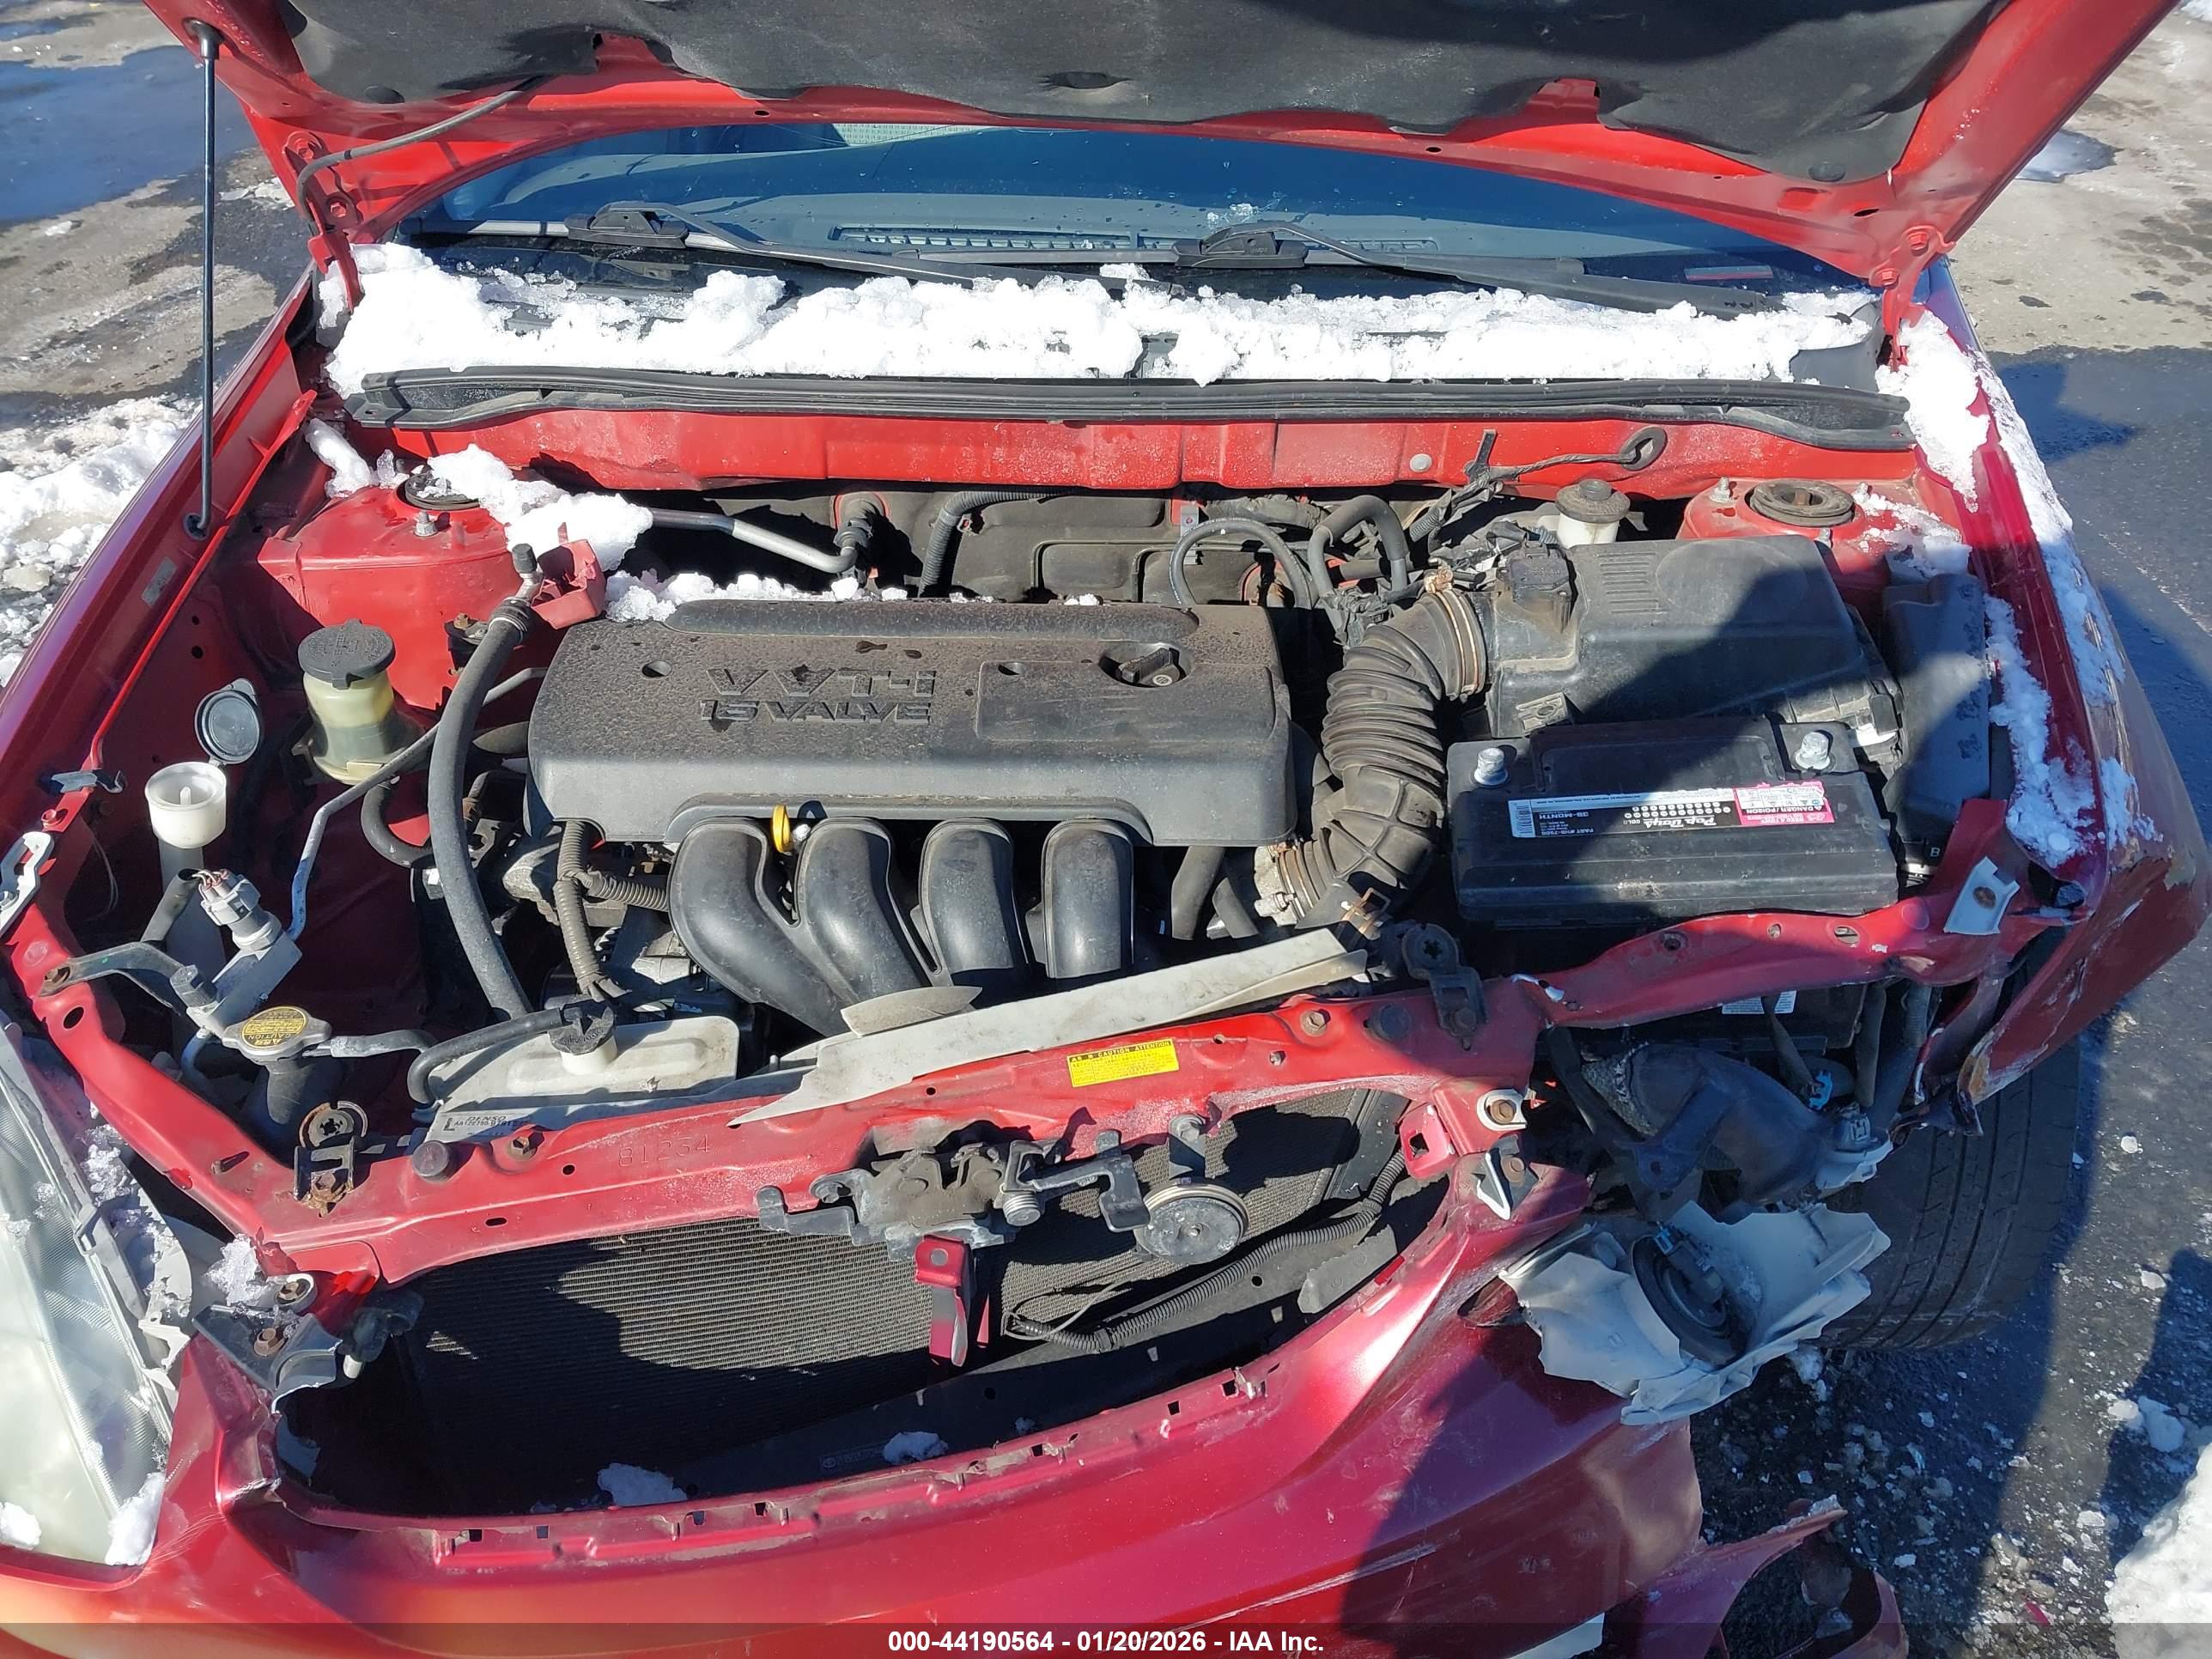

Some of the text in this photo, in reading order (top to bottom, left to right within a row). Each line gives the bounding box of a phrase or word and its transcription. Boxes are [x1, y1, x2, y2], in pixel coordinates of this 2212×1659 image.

[699, 699, 933, 724] 16 VALVE
[1929, 847, 1941, 857] B
[1098, 1042, 1170, 1057] CAUTION ATTENTION
